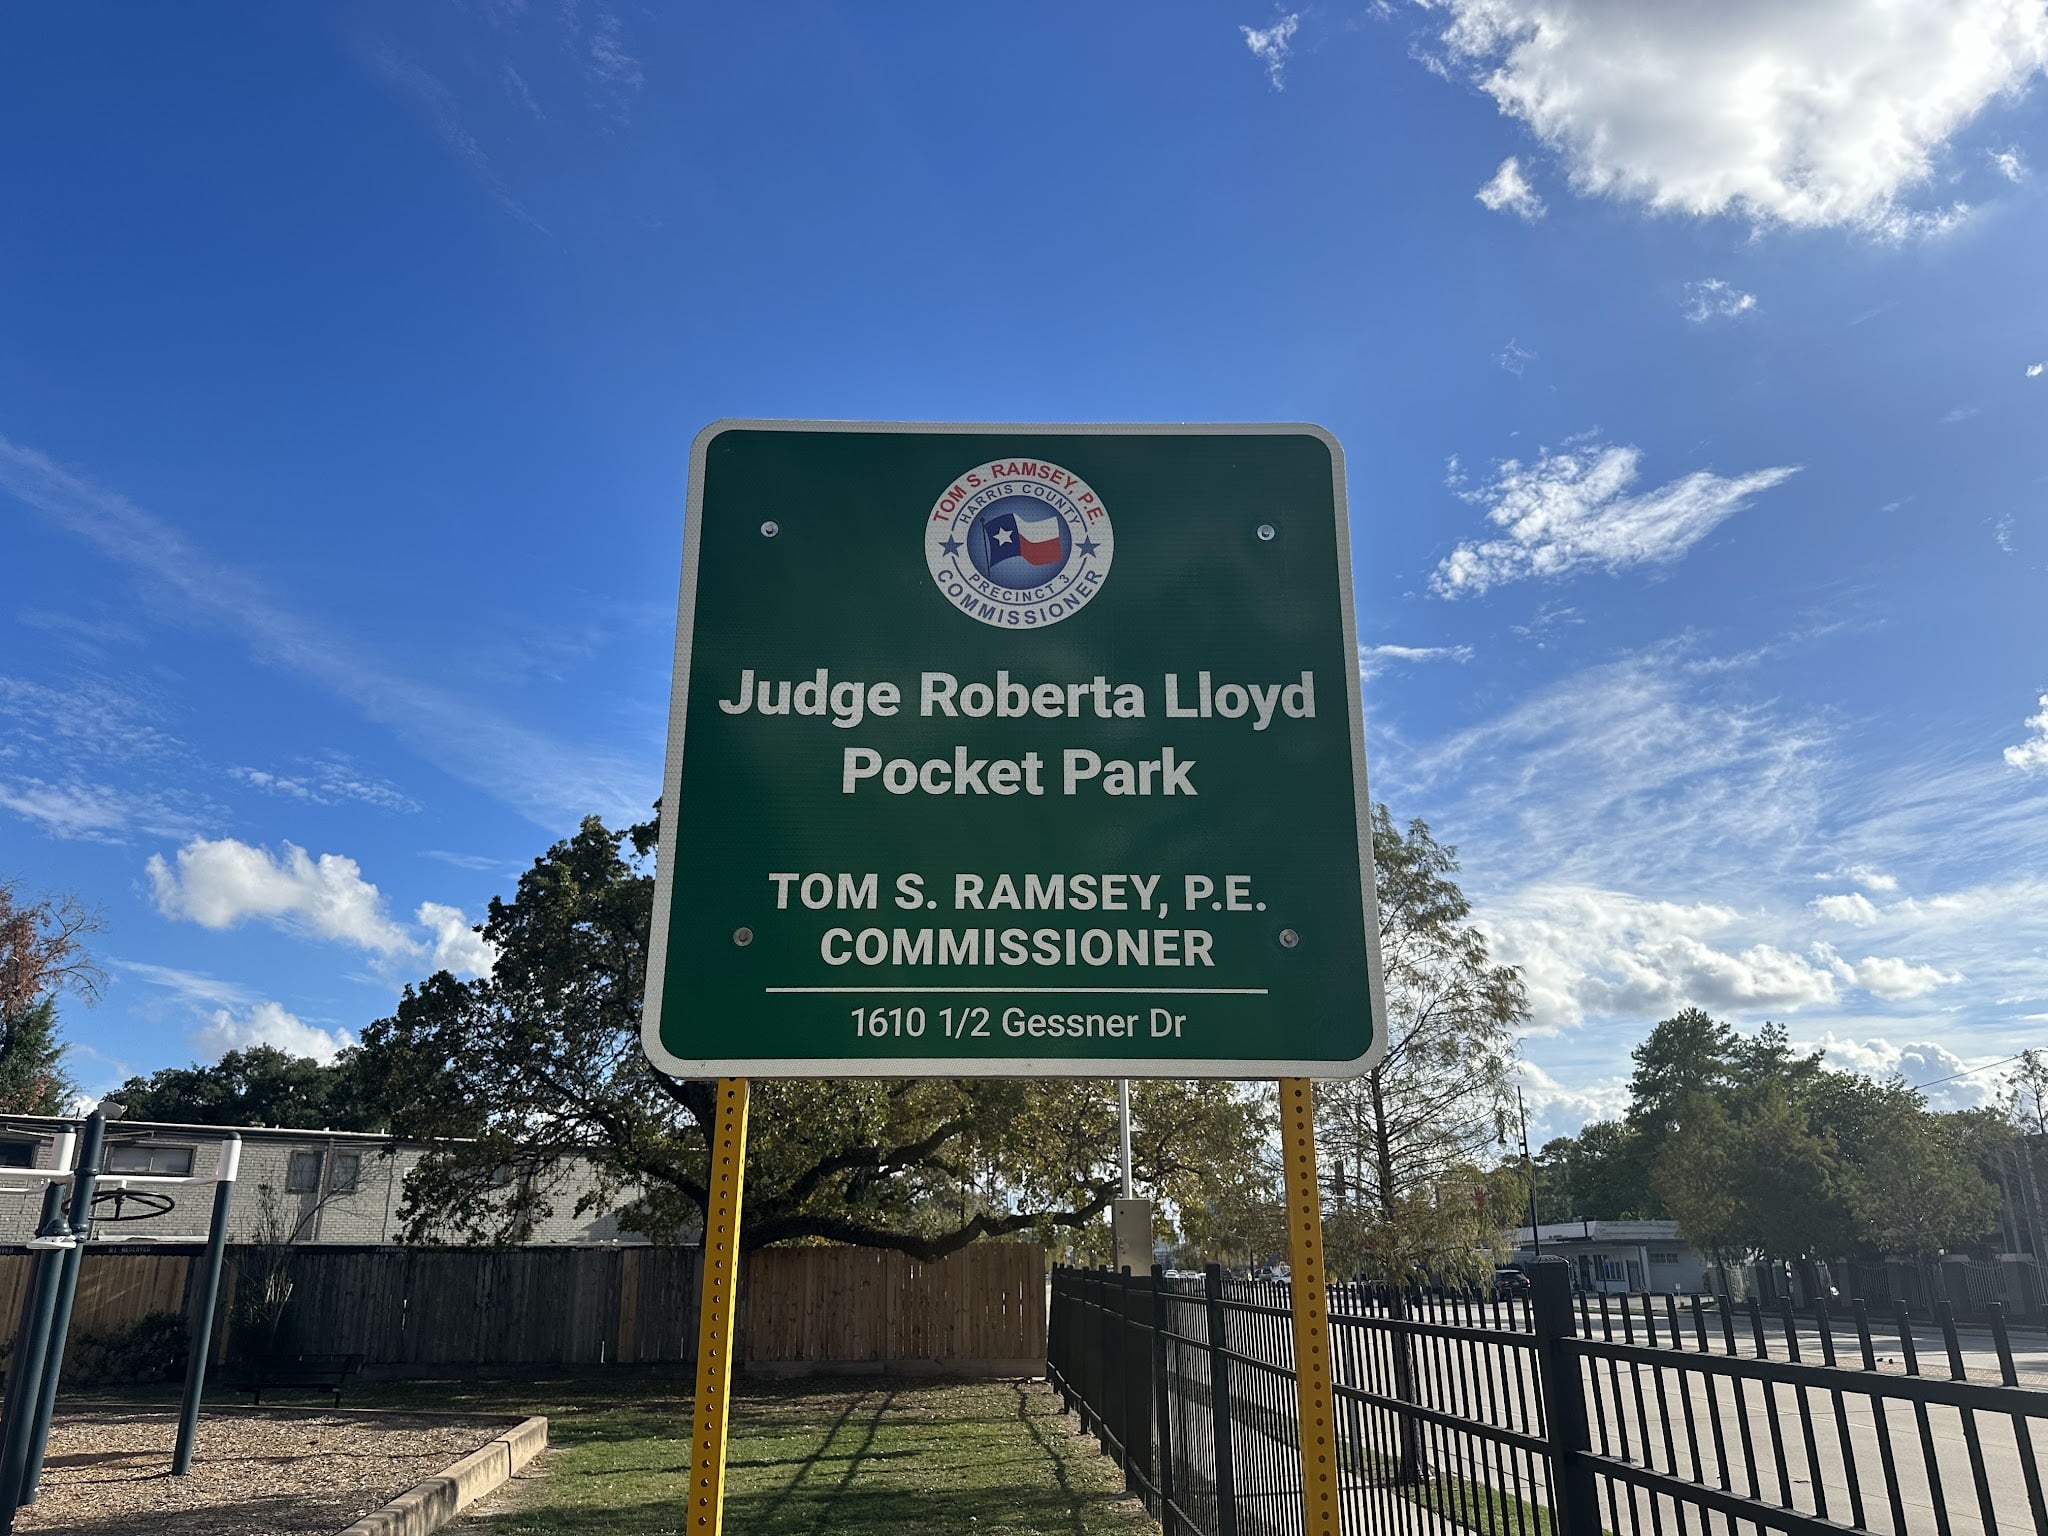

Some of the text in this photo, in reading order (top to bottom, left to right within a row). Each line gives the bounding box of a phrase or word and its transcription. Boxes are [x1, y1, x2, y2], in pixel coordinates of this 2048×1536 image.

[932, 462, 1104, 526] TOM S. RAMSEY, P.E.
[959, 484, 1081, 525] HARRIS COUNTY
[937, 569, 1103, 625] COMMISSIONER
[968, 573, 1070, 602] PRECINCT 3
[719, 669, 1315, 730] Judge Roberta Lloyd
[843, 746, 1197, 795] Pocket Park
[769, 873, 1265, 919] TOM S. RAMSEY, P.E.
[821, 927, 1215, 967] COMMISSIONER
[852, 1008, 1186, 1038] 1610 1/2 Gessner Dr
